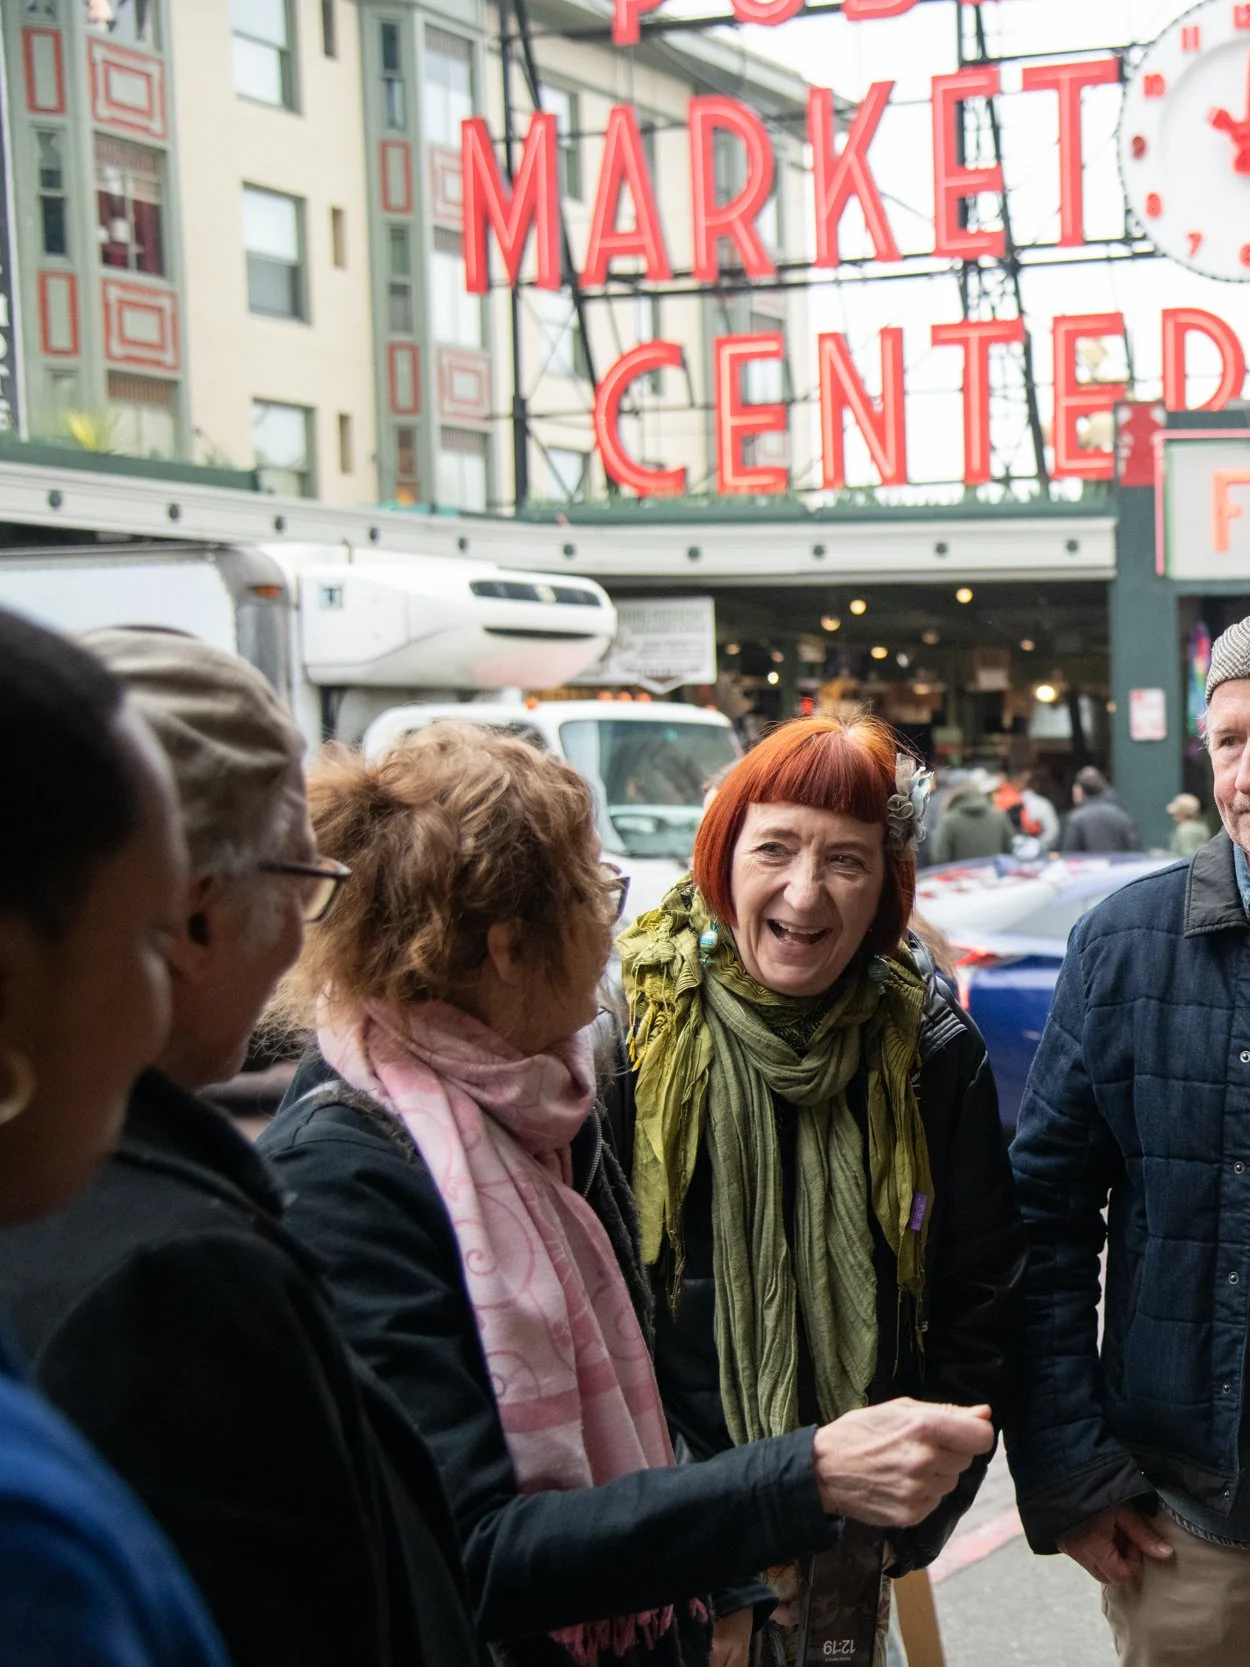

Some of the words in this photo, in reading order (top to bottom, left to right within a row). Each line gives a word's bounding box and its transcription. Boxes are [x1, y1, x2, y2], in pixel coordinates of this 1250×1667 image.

[1182, 26, 1199, 50] 11
[461, 56, 1119, 294] MARKET
[823, 1639, 856, 1655] 12:19
